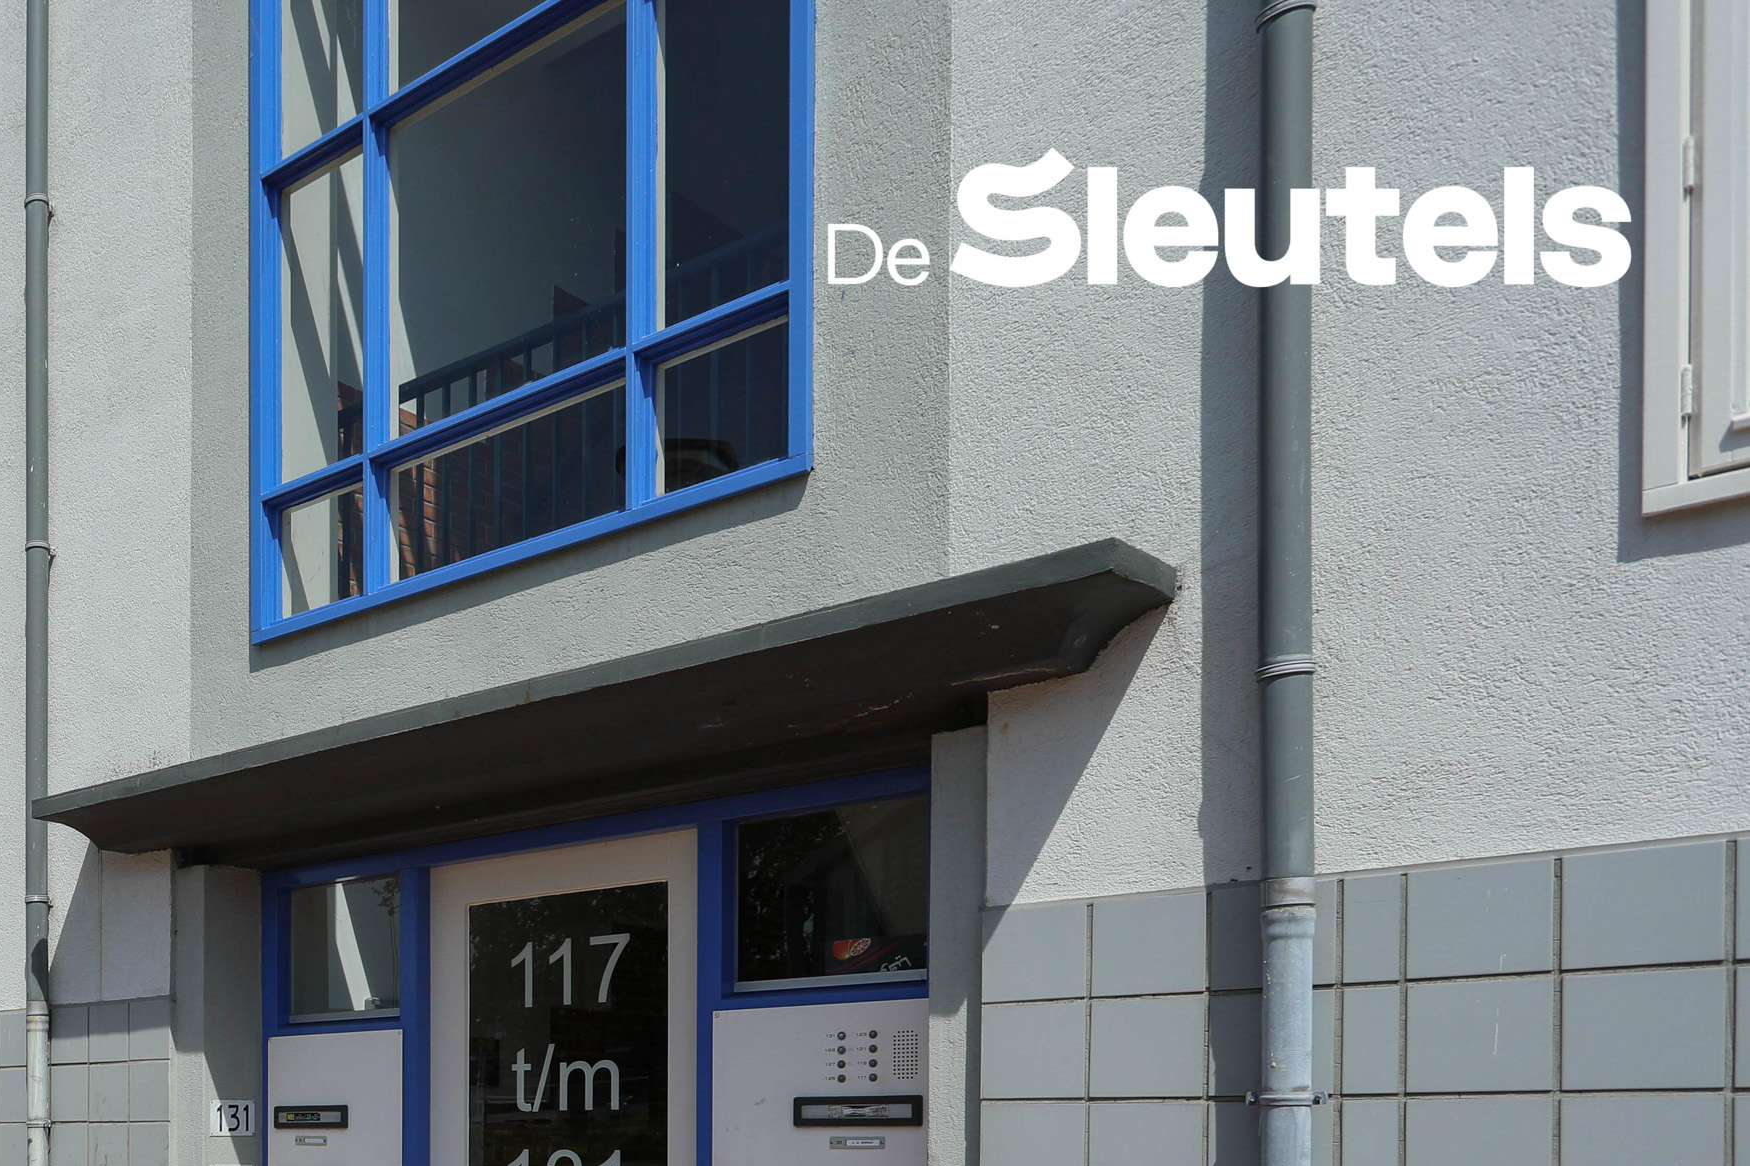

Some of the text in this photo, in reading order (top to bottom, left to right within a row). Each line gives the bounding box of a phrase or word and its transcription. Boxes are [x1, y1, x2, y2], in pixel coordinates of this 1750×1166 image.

[511, 933, 631, 1008] 117
[511, 1043, 620, 1113] t/m
[217, 1104, 249, 1132] 131
